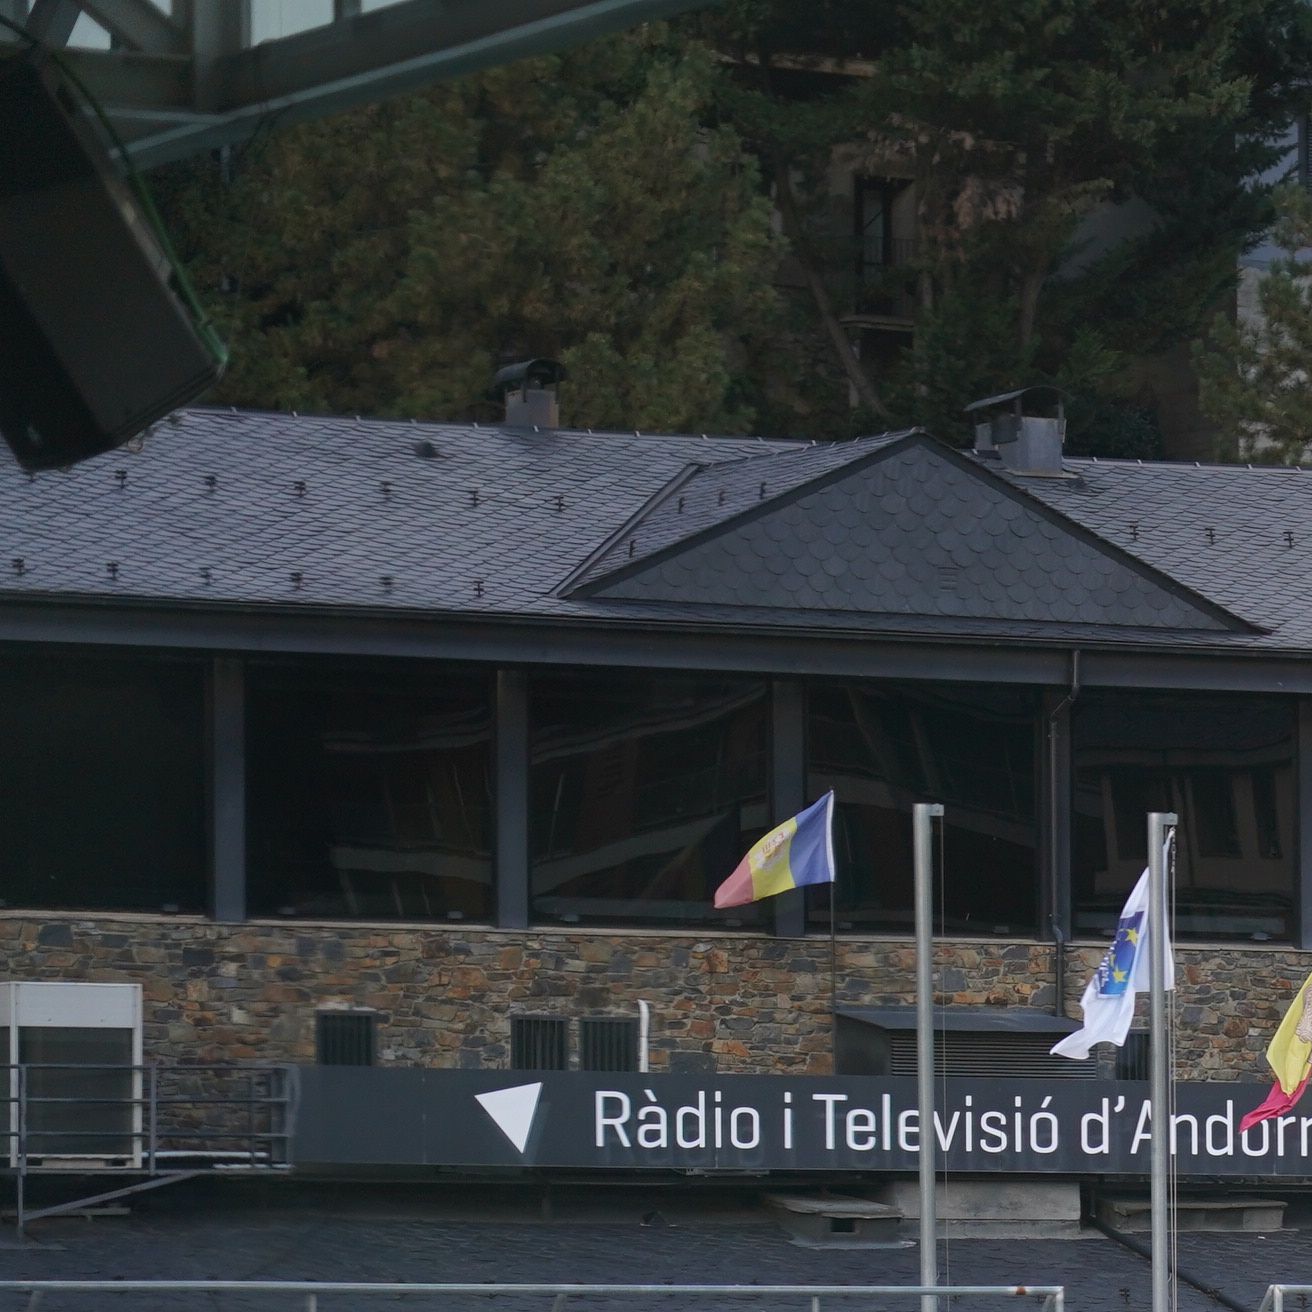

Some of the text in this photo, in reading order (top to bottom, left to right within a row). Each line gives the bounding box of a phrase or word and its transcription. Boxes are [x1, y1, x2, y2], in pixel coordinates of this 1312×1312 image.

[594, 1089, 761, 1149] Ràdio
[783, 1091, 793, 1149] i
[812, 1093, 1058, 1154] Televisió
